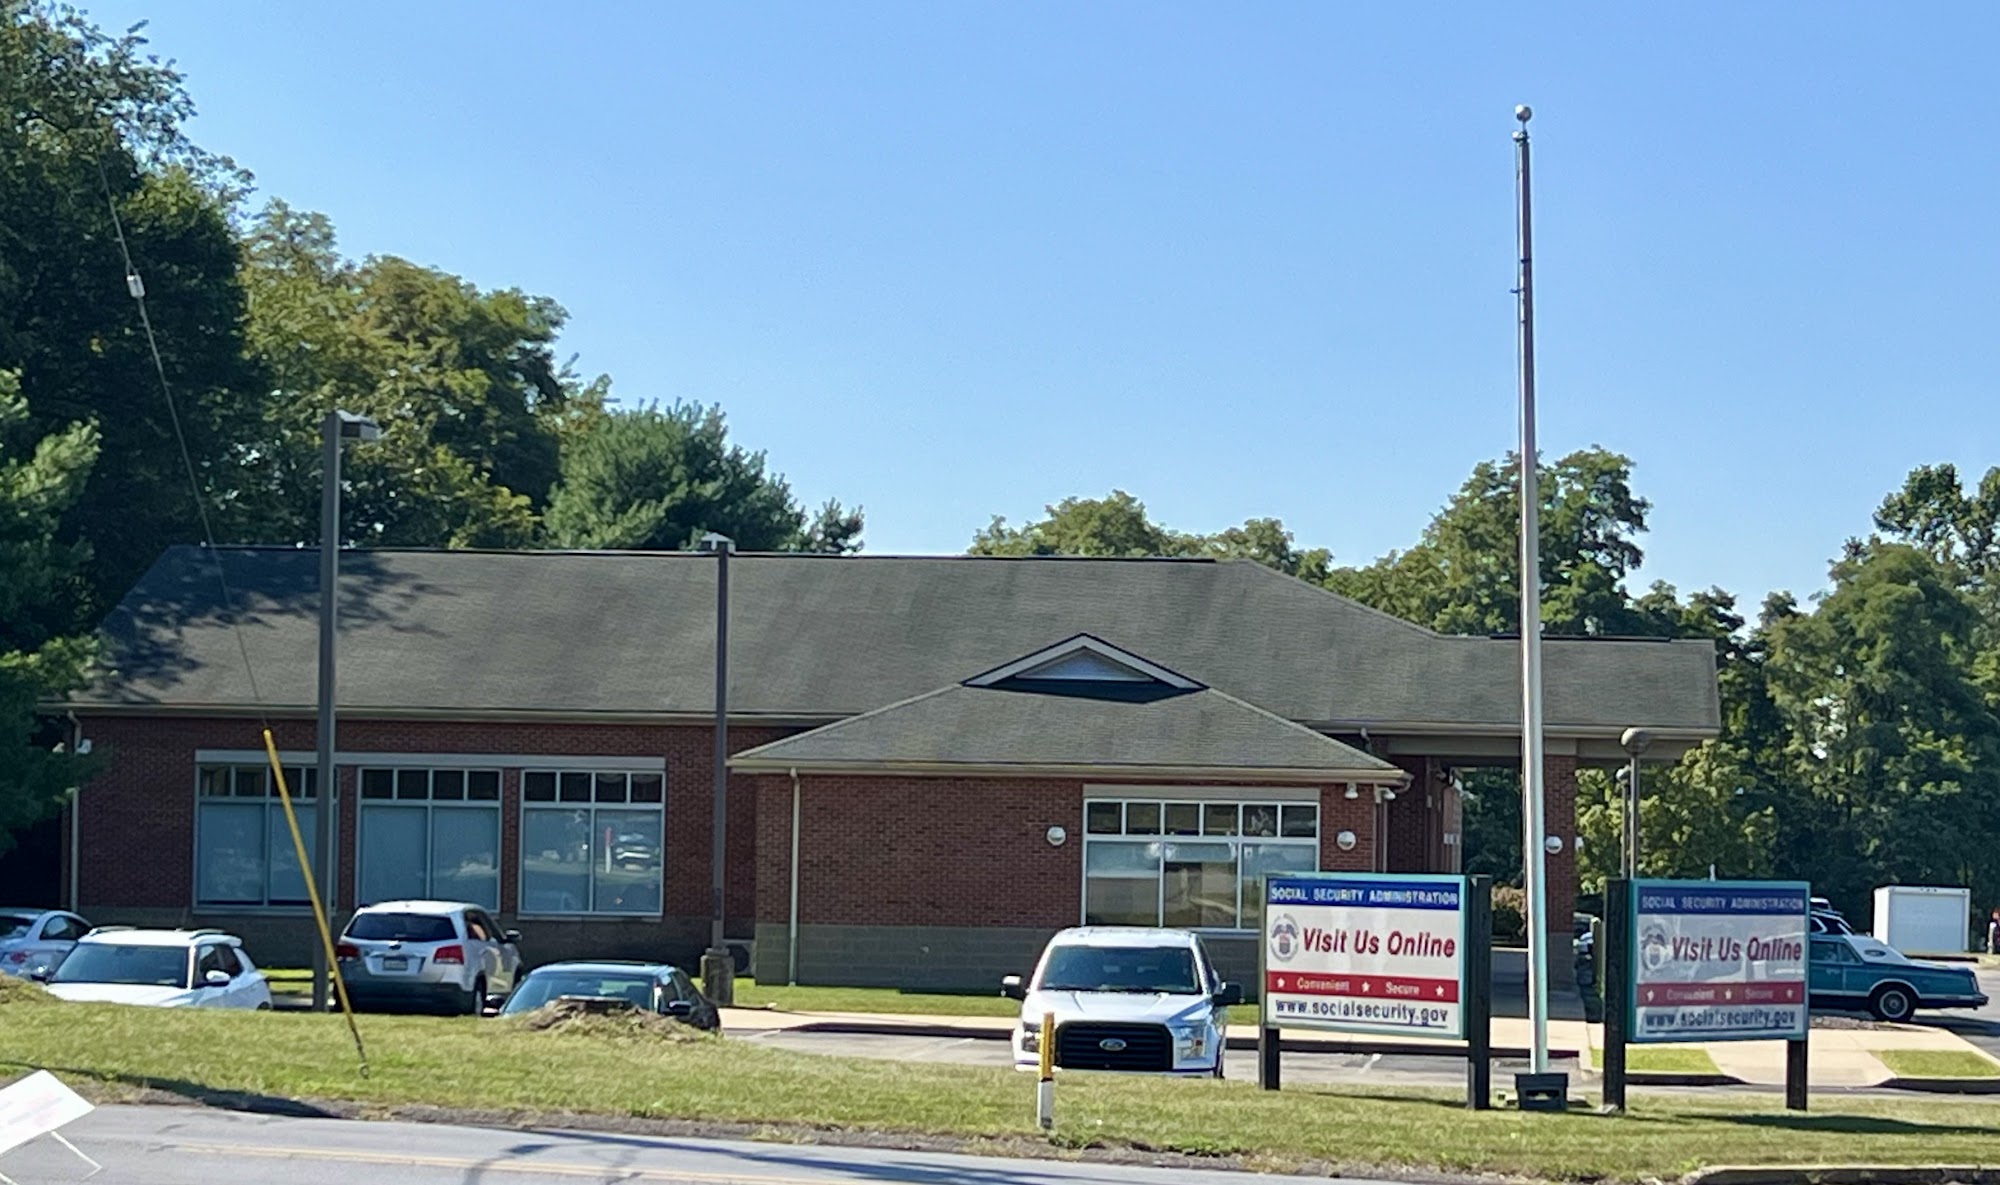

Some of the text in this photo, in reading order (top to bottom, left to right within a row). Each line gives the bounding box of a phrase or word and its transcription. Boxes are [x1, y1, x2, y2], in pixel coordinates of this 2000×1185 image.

[1271, 887, 1458, 905] SOCIAL SECURITY ADMINISTRATION
[1642, 896, 1676, 909] SOCIAL
[1683, 896, 1726, 909] SECURITY
[1303, 928, 1455, 957] Visit Us Online
[1672, 937, 1801, 961] Visit Us Online
[1296, 977, 1350, 991] Convenient
[1385, 982, 1420, 995] Secure
[1275, 999, 1448, 1024] www.socialsecurity.gov
[1646, 1009, 1796, 1029] www.socialsecurity.gov
